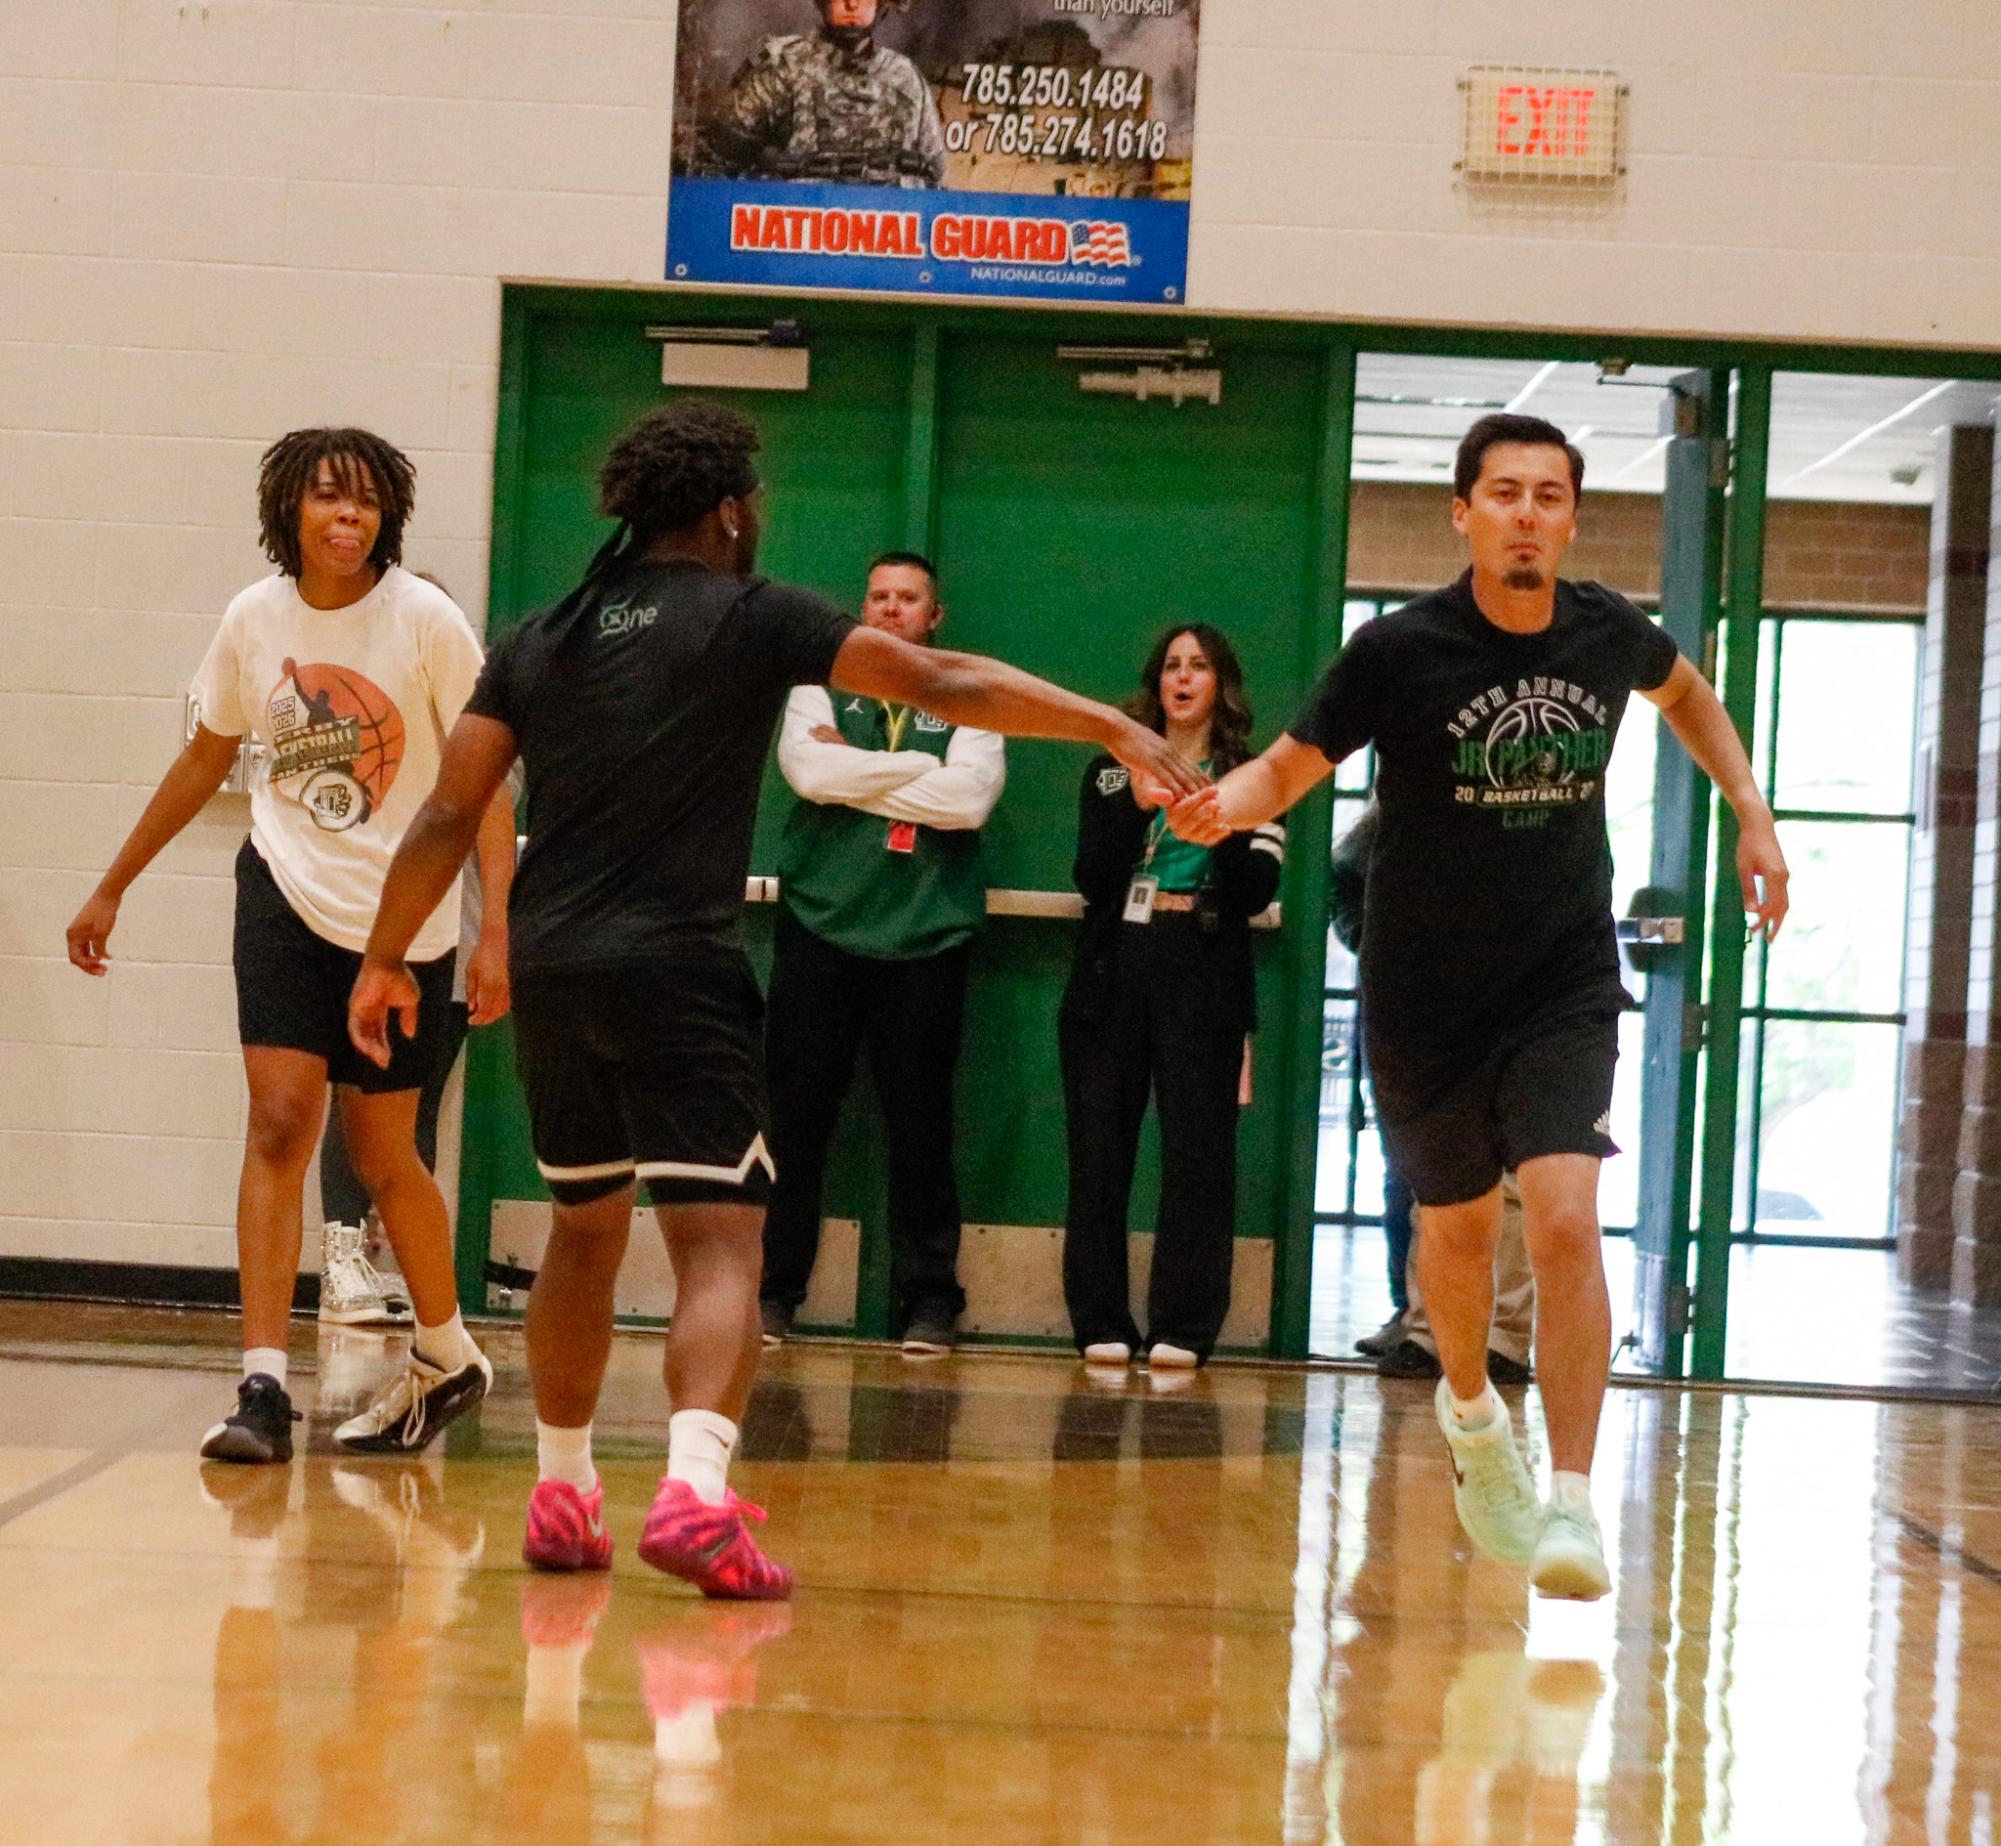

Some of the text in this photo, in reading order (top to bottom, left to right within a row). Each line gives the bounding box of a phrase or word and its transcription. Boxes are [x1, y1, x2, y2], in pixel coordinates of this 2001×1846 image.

[1101, 0, 1175, 20] yourself
[962, 63, 1145, 111] 785.250.1484
[945, 112, 1168, 161] or 785.274.1618
[1496, 86, 1596, 155] EXIT
[730, 203, 1069, 265] NATIONAL GUARD
[970, 265, 1127, 287] NATIONALGUARD.com
[1447, 676, 1608, 739] 12TH ANNUAL
[1454, 785, 1475, 802] 20
[1482, 786, 1575, 803] BASKETBALL
